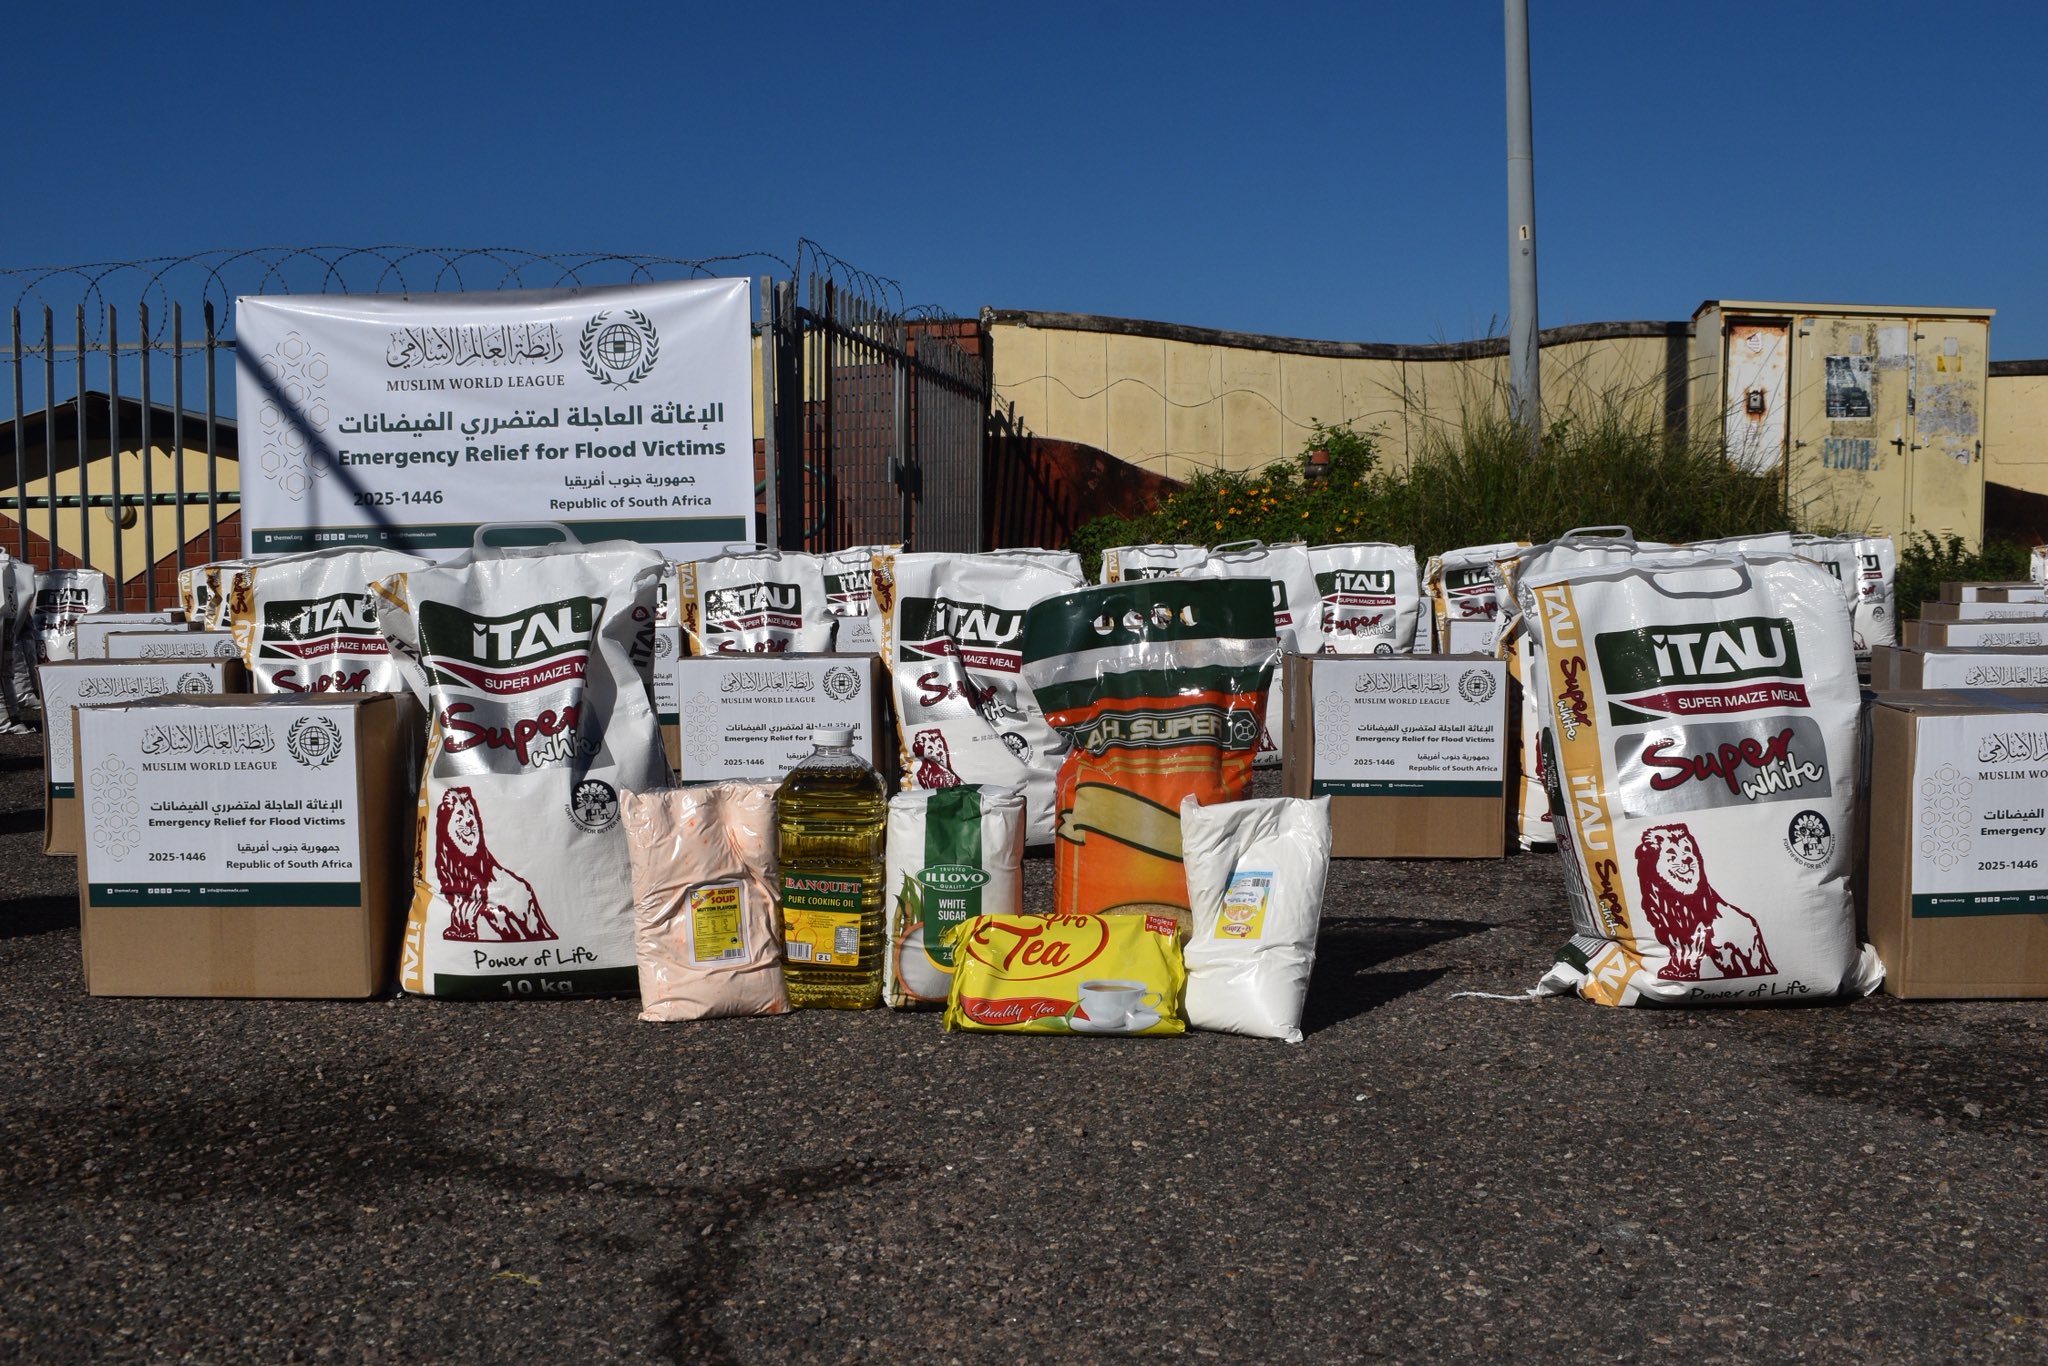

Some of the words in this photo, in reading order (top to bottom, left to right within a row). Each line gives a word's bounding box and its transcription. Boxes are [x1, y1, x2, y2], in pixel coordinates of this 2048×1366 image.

[1521, 225, 1527, 239] 1
[386, 379, 445, 392] MUSLIM
[449, 377, 504, 390] WORLD
[508, 375, 565, 388] LEAGUE
[567, 405, 643, 432] العاجلة
[651, 401, 724, 431] الإغاثة
[338, 411, 453, 438] الفيضانات
[460, 408, 559, 441] لمتضرري
[338, 449, 459, 468] Emergency
[465, 444, 530, 462] Relief
[535, 443, 569, 460] for
[575, 440, 637, 459] Flood
[642, 439, 726, 457] Victims
[564, 471, 605, 489] أفريقيا
[608, 474, 642, 488] جنوب
[645, 473, 696, 488] جمهورية
[353, 490, 444, 506] 2025-1446
[549, 497, 607, 512] Republic
[610, 496, 625, 508] of
[628, 494, 668, 508] South
[671, 494, 712, 507] Africa
[1334, 571, 1391, 592] iTAU
[300, 599, 380, 635] iTAU
[781, 618, 799, 628] MEAL
[934, 602, 1022, 642] iTAU
[1322, 612, 1384, 635] Super
[1541, 585, 1578, 648] TAU
[1357, 623, 1394, 639] white
[304, 645, 330, 655] SUPER
[331, 642, 360, 651] MAIZE
[362, 642, 388, 651] MEAL
[1651, 625, 1787, 678] iTAU
[963, 654, 988, 666] MAIZE
[989, 656, 1017, 669] MEAL
[484, 676, 530, 690] SUPER
[533, 663, 571, 685] MAIZE
[1558, 655, 1592, 727] Super
[1678, 695, 1722, 709] SUPER
[1724, 691, 1768, 708] MAIZE
[1771, 690, 1802, 703] MEAL
[725, 723, 767, 733] الفيضانات
[1130, 714, 1223, 740] SUPER
[1556, 700, 1581, 741] white
[440, 702, 584, 765] Super
[724, 735, 769, 743] Emergency
[1355, 735, 1400, 743] Emergency
[1401, 735, 1425, 743] Relief
[1427, 735, 1440, 743] for
[142, 762, 187, 771] MUSLIM
[190, 762, 231, 771] WORLD
[234, 761, 277, 771] LEAGUE
[723, 758, 765, 766] 2025-1446
[1353, 758, 1395, 766] 2025-1446
[1408, 765, 1441, 773] Republic
[1641, 728, 1795, 795] Super
[1742, 752, 1824, 800] white
[1978, 770, 2025, 781] MUSLIM
[150, 801, 208, 814] الفيضانات
[211, 800, 261, 815] لمتضرري
[264, 799, 303, 813] العاجلة
[306, 799, 343, 813] الإغاثة
[1571, 775, 1609, 850] iTAU
[148, 818, 211, 828] Emergency
[214, 817, 246, 827] Relief
[249, 817, 267, 826] for
[269, 816, 301, 826] Flood
[303, 816, 346, 826] Victims
[564, 804, 584, 831] FORTIFIED
[1983, 808, 2045, 821] الفيضانات
[1981, 826, 2046, 836] Emergency
[237, 840, 269, 854] أفريقيا
[272, 844, 298, 854] جنوب
[301, 843, 340, 854] جمهورية
[1783, 838, 1804, 865] FORTIFIED
[1815, 855, 1831, 869] BETTER
[148, 852, 206, 862] 2025-1446
[226, 860, 272, 871] Republic
[274, 860, 285, 869] of
[287, 860, 319, 869] South
[321, 860, 353, 869] Africa
[1978, 860, 2038, 871] 2025-1446
[785, 877, 861, 894] BANQUET
[926, 872, 984, 883] ILLOVO
[711, 896, 736, 904] SOUP
[788, 895, 806, 904] PURE
[808, 896, 841, 906] COOKING
[843, 900, 855, 908] OIL
[1594, 858, 1629, 929] Super
[938, 899, 966, 909] WHITE
[938, 910, 967, 921] SUGAR
[1150, 916, 1173, 927] Tagless
[1599, 900, 1619, 936] white
[1159, 925, 1174, 934] Bags
[974, 921, 1072, 972] Tea
[473, 950, 528, 969] Power
[534, 950, 551, 967] of
[556, 946, 598, 964] Life
[502, 979, 533, 995] 10
[541, 978, 574, 994] kg
[1689, 986, 1745, 1001] Power
[1749, 982, 1767, 998] of
[1771, 979, 1811, 996] Life
[971, 1001, 1024, 1022] Quality
[1030, 1001, 1056, 1017] Tea
